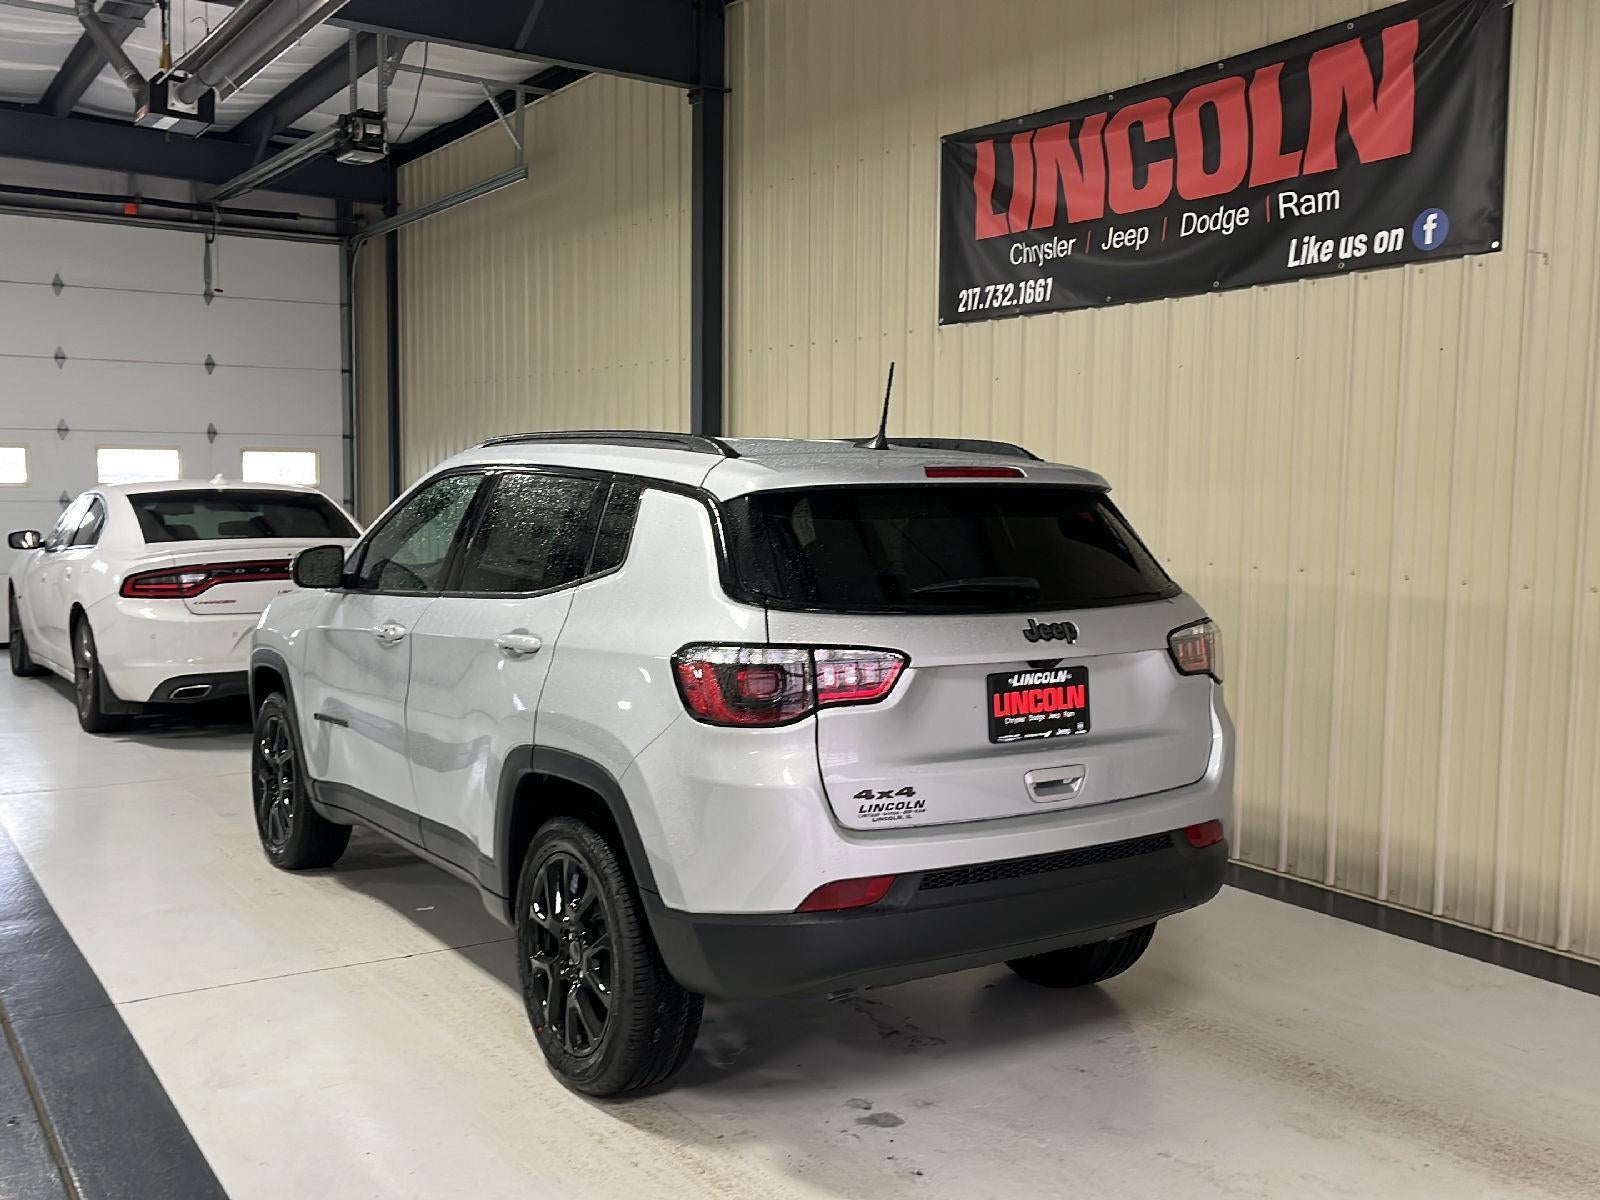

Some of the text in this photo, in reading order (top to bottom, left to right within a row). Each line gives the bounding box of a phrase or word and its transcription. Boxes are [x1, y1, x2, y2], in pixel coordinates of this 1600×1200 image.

[974, 19, 1419, 240] LINCOLN
[1010, 189, 1340, 267] Chrysler Jeep Dodge Ram
[1287, 235, 1333, 268] Like
[1339, 232, 1367, 259] us
[1374, 227, 1405, 253] on
[958, 277, 1053, 313] 217.732.1661
[1022, 618, 1079, 645] Jeep
[1010, 670, 1069, 687] LINCOLN
[993, 685, 1085, 718] LINCOLN
[853, 786, 916, 800] 4x4
[858, 800, 925, 813] LINCOLN
